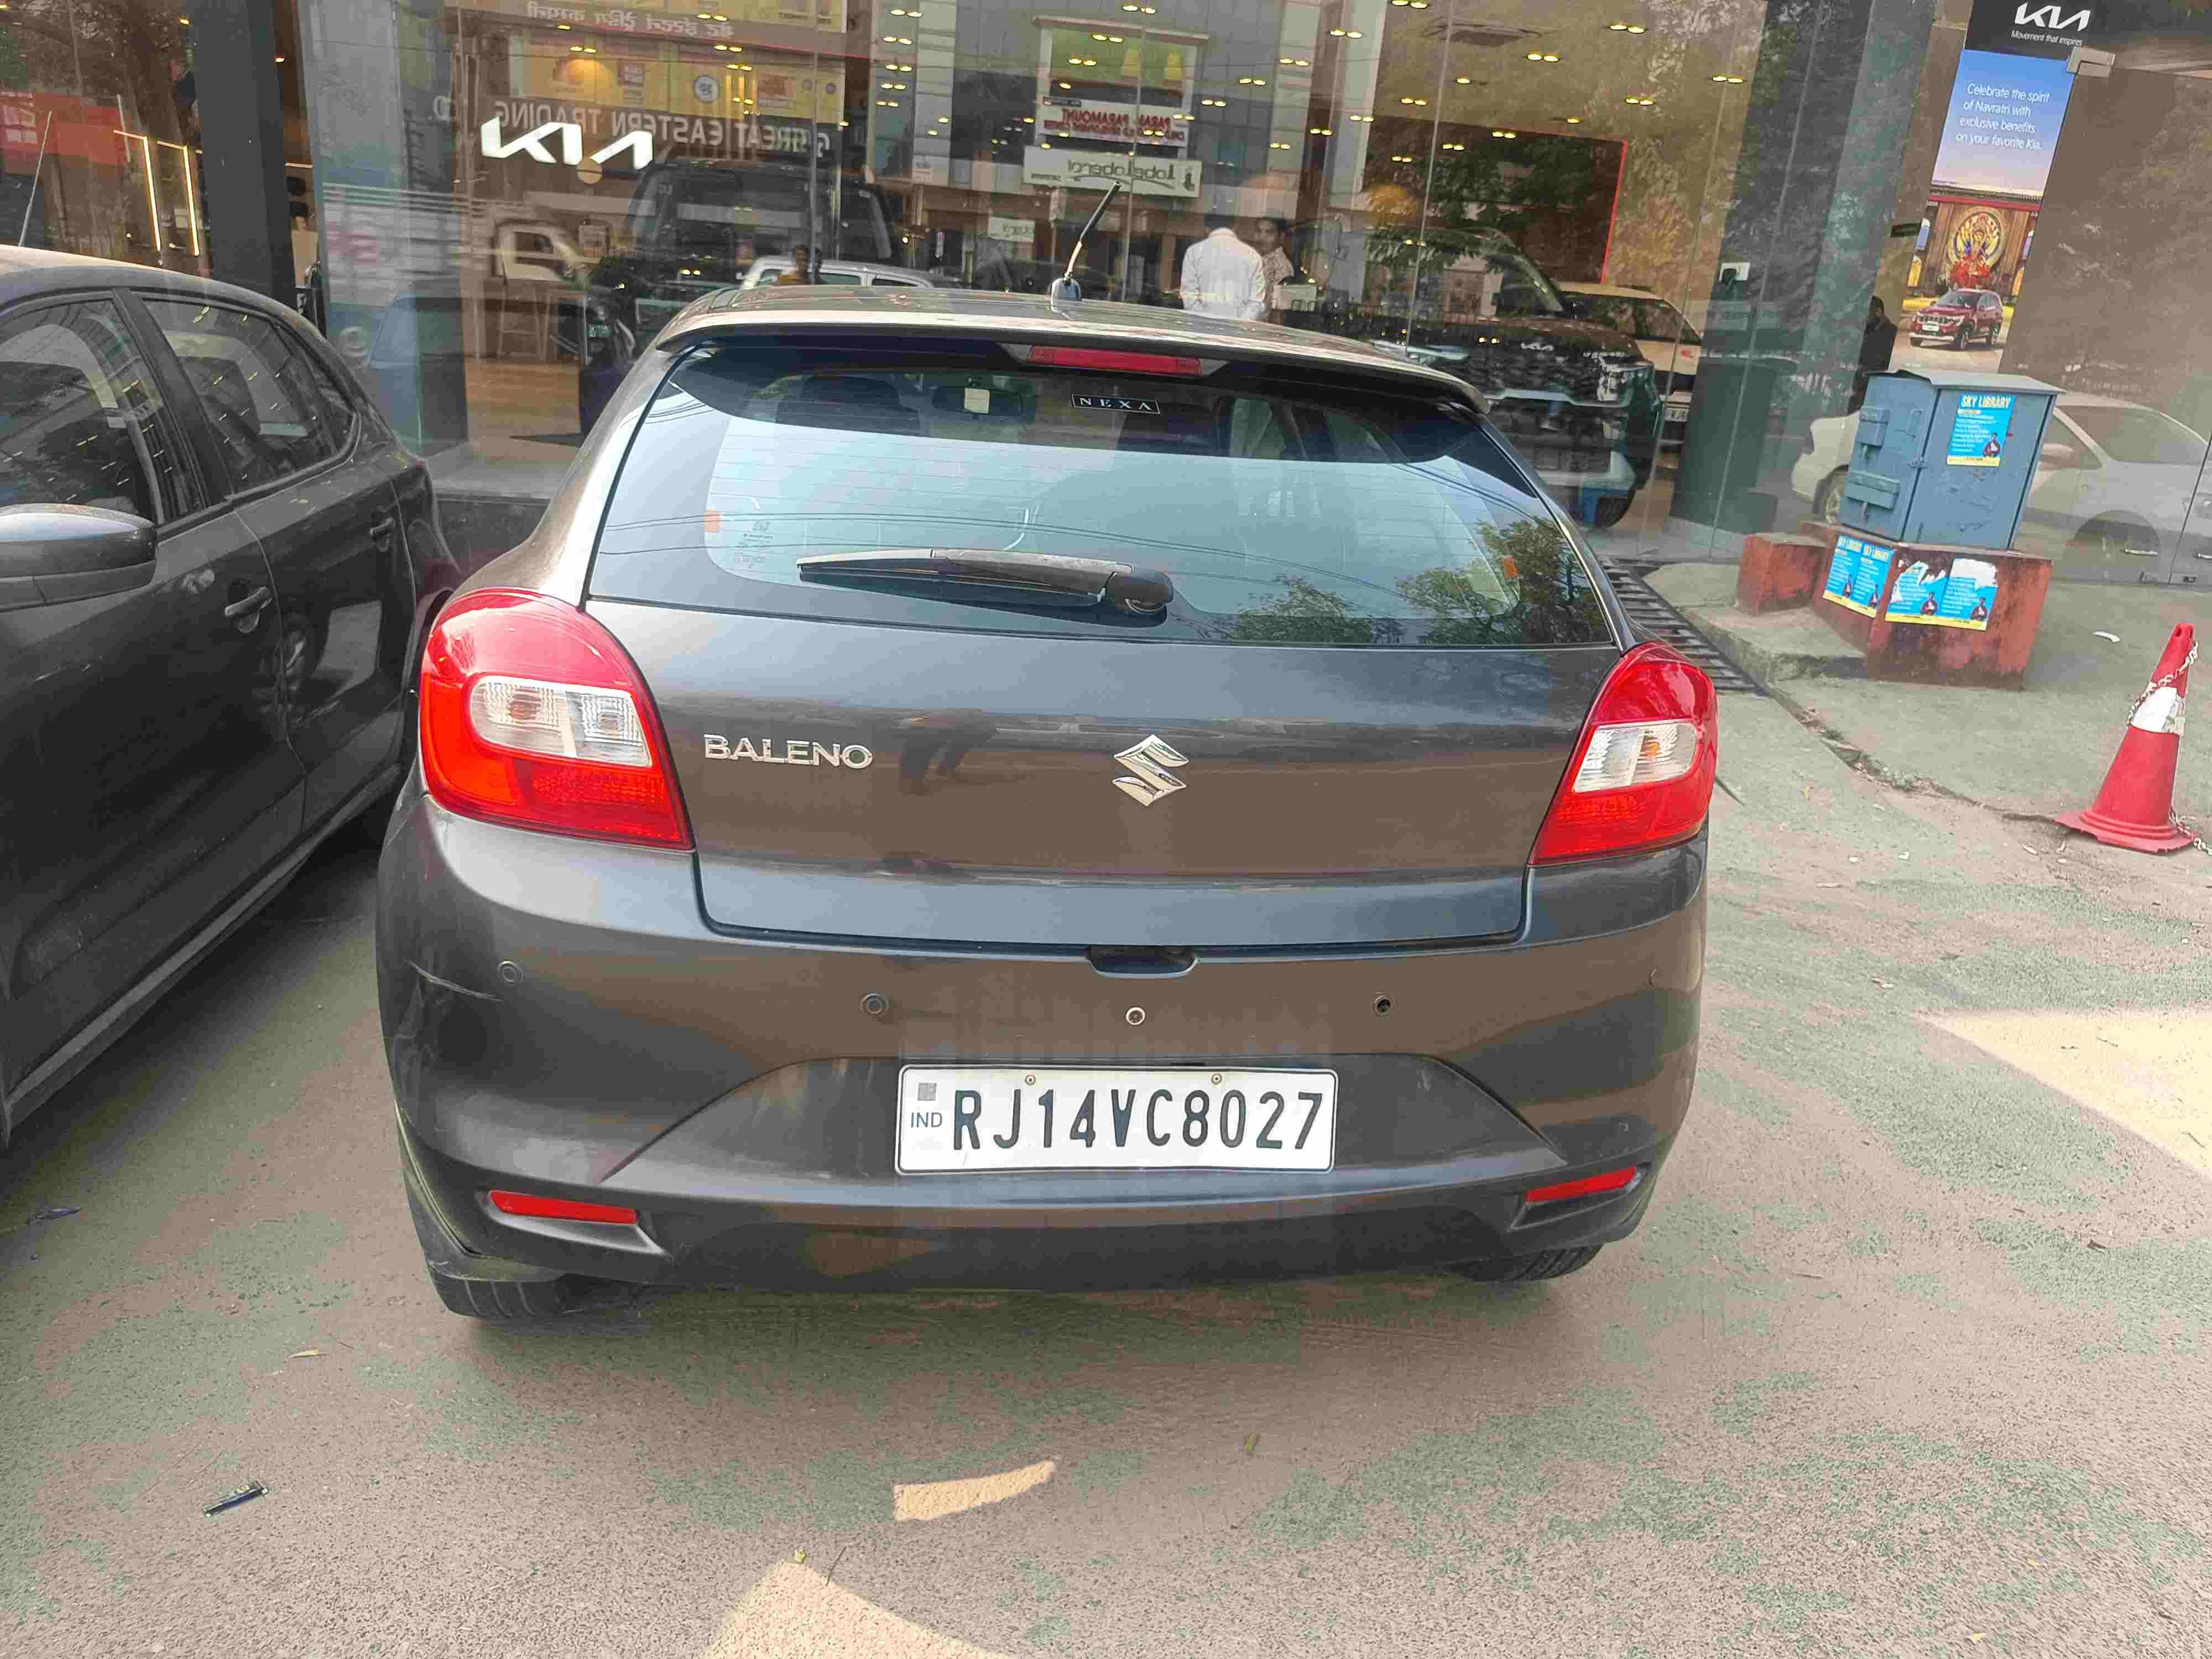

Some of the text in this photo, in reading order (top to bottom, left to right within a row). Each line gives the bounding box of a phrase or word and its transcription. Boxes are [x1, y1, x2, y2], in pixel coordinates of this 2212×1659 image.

[2015, 2, 2091, 32] KIA
[2011, 30, 2084, 46] Movement that inspires
[1967, 83, 2051, 104] Celebrate the spirit
[1963, 100, 2031, 117] of Navratri with
[1959, 117, 2036, 133] exclusive benefits
[481, 116, 653, 170] KIA
[1955, 133, 2043, 150] on your favorite Kia.
[1079, 398, 1152, 410] NEXA
[1960, 395, 2011, 409] SKY LIBRARY
[703, 734, 873, 769] BALENO
[911, 1089, 1323, 1150] IND RJ14VC8027
